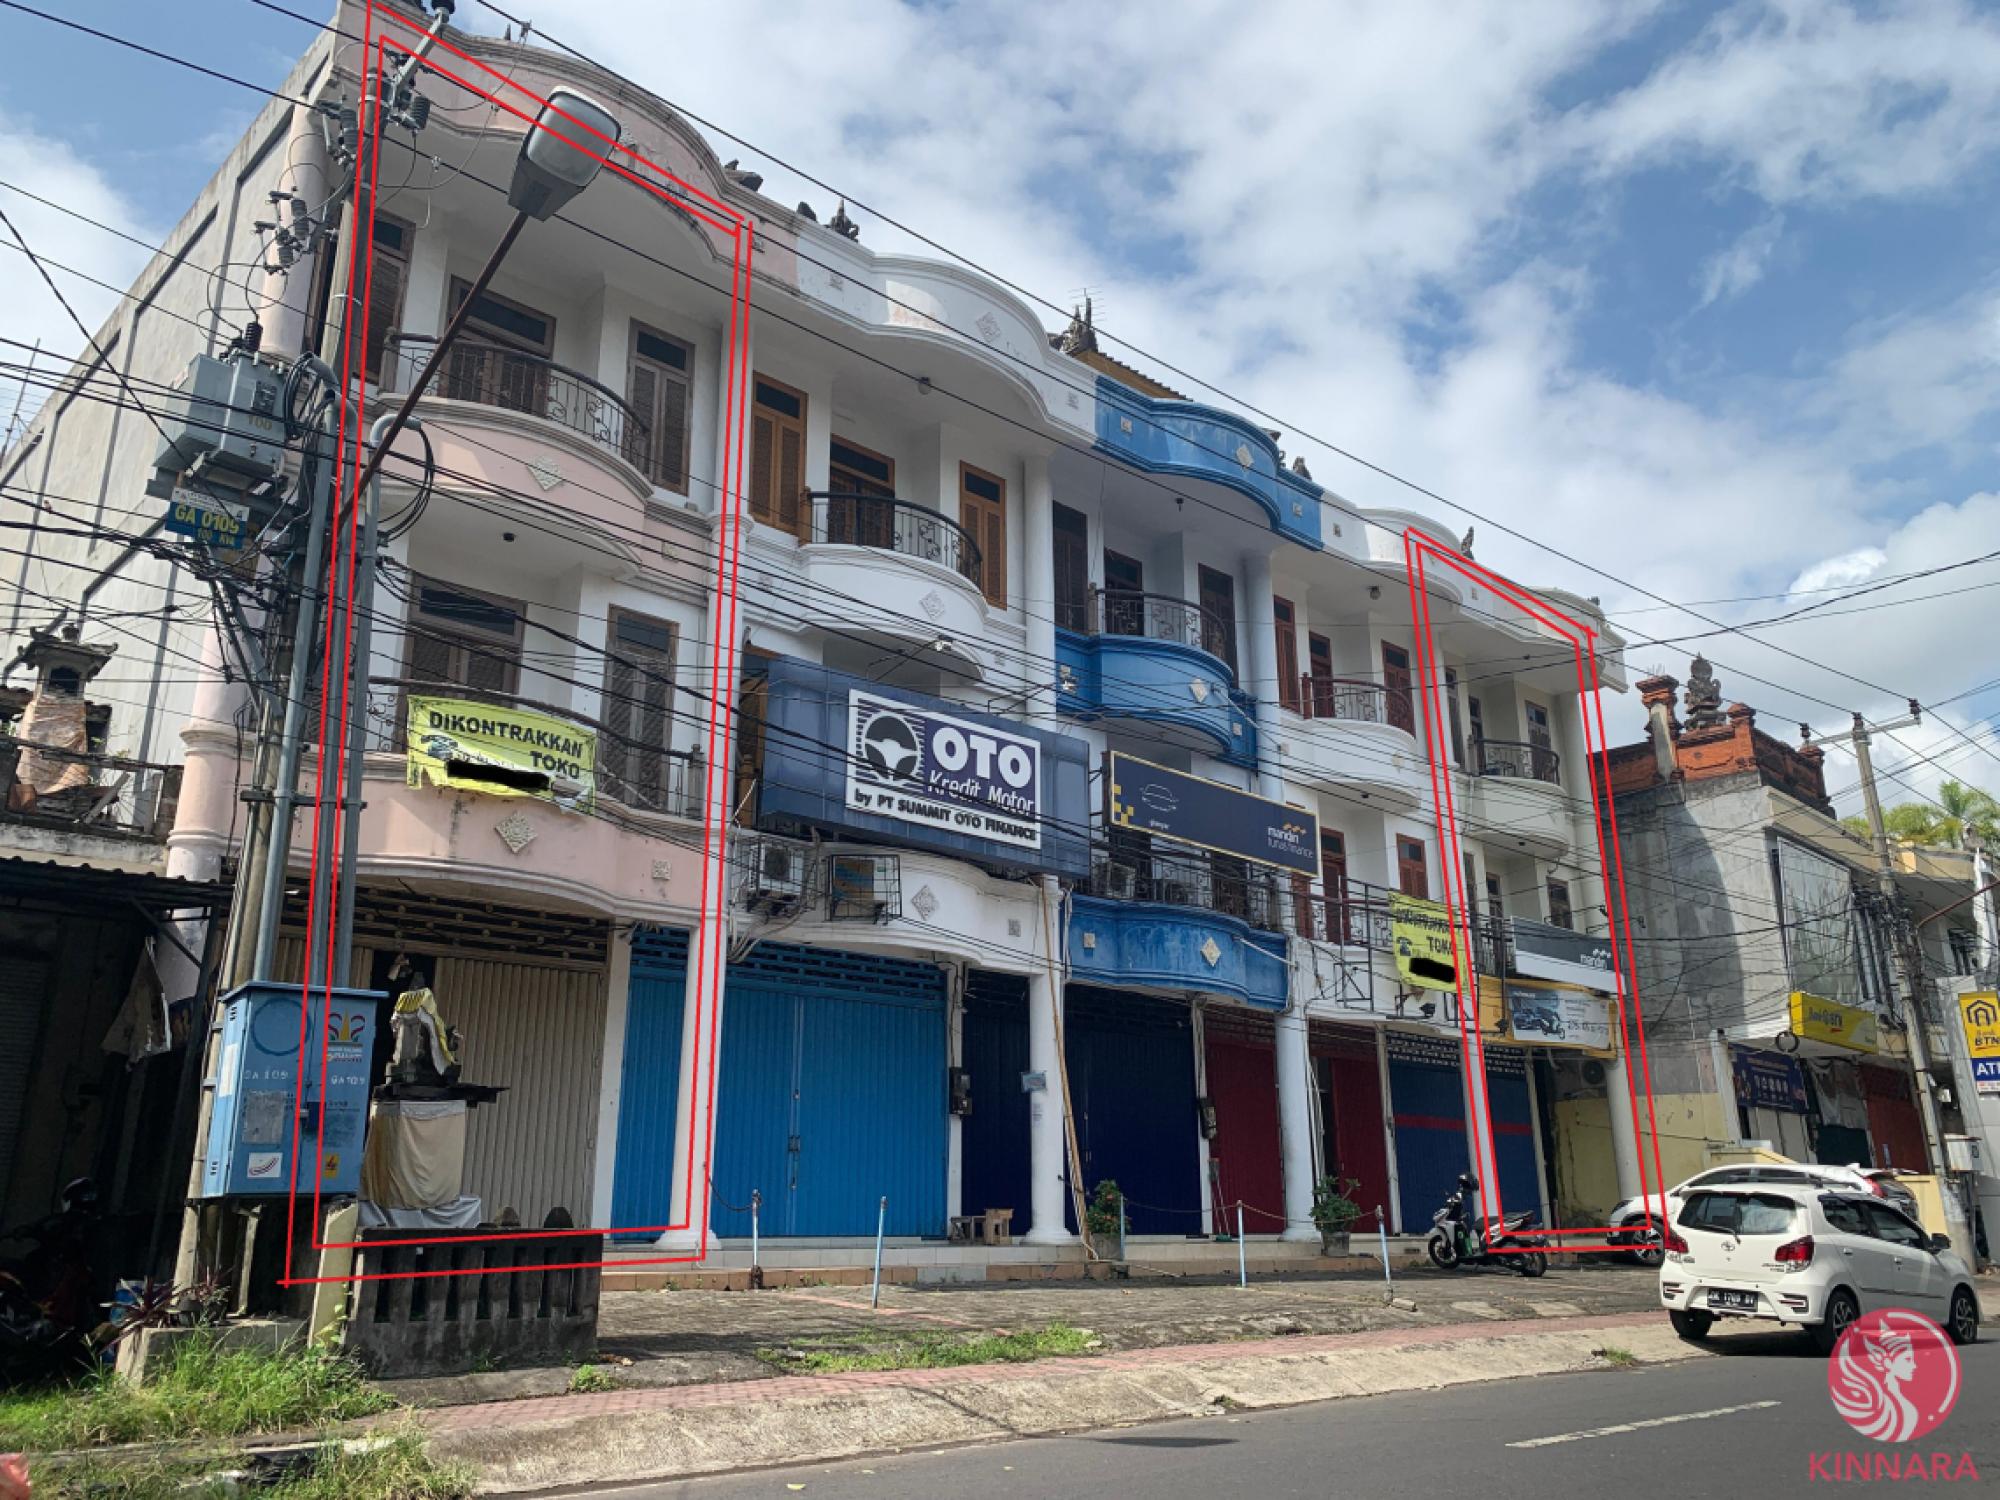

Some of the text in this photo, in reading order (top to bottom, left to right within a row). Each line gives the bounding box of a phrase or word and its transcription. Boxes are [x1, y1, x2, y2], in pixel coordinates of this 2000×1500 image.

[175, 504, 196, 525] GA
[430, 711, 583, 758] DIKONTRAKKAN
[932, 727, 1032, 788] OTO
[529, 750, 580, 780] TOKO
[855, 788, 1037, 842] by PT SUMMIT OTO FINANCE
[928, 770, 1035, 816] Kredit Motor
